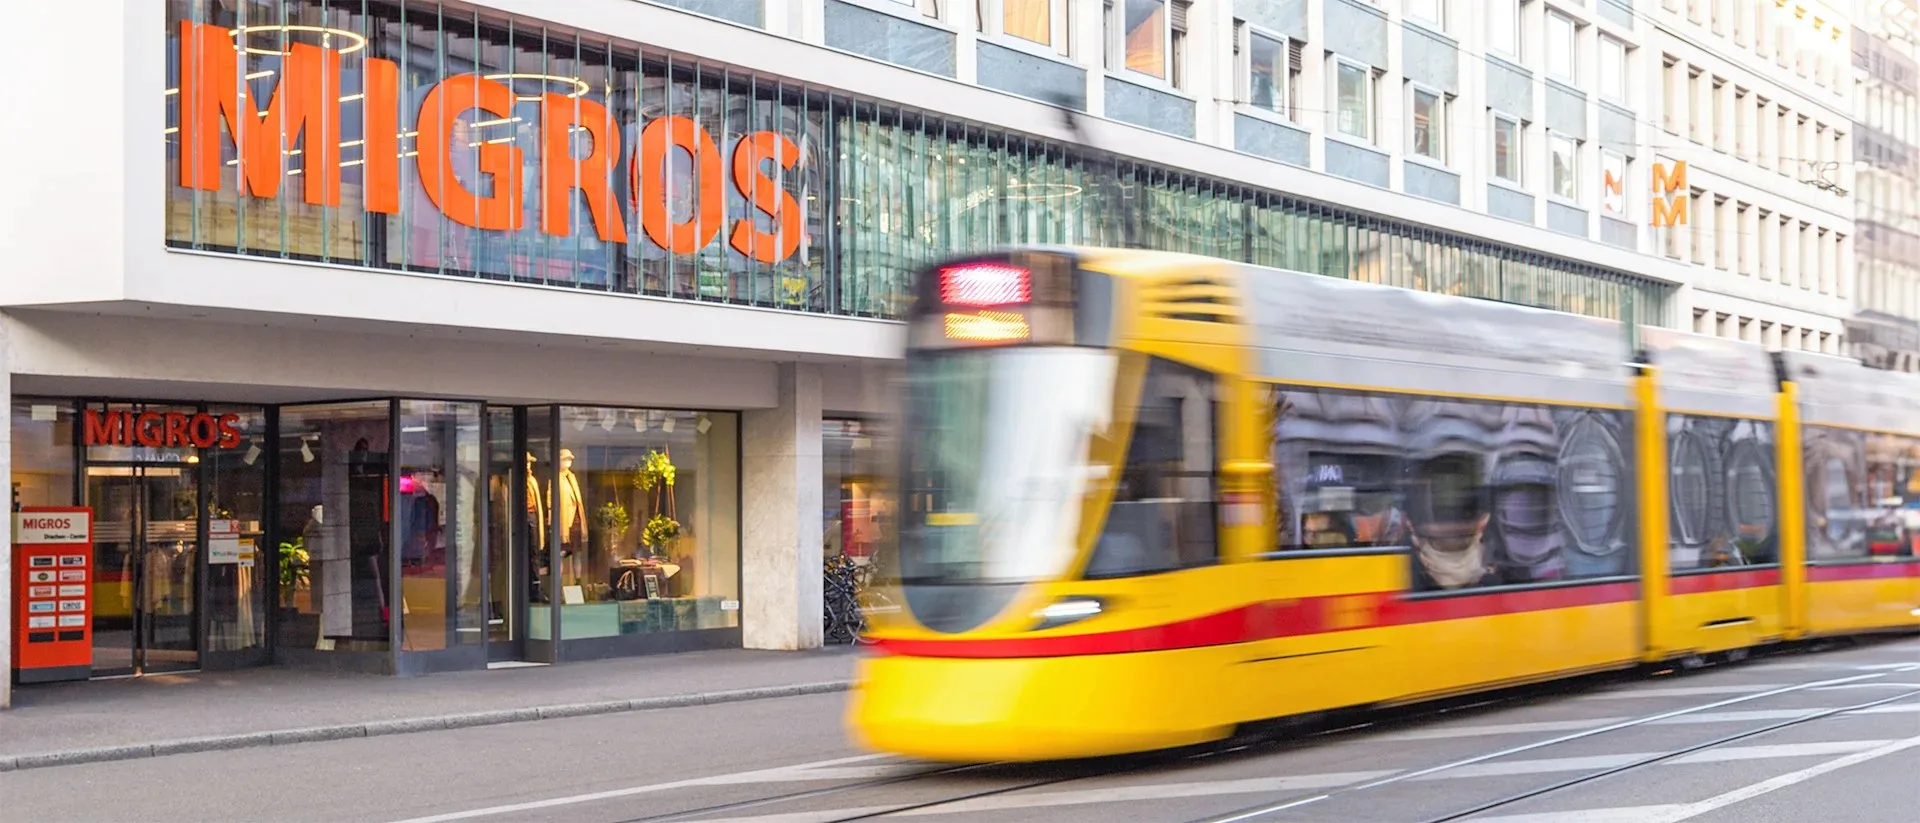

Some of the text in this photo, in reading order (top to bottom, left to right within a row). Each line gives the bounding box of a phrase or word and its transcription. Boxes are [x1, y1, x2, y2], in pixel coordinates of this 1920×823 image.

[180, 19, 803, 265] MIGROS
[83, 409, 241, 448] MIGROS
[23, 518, 71, 530] MIGROS
